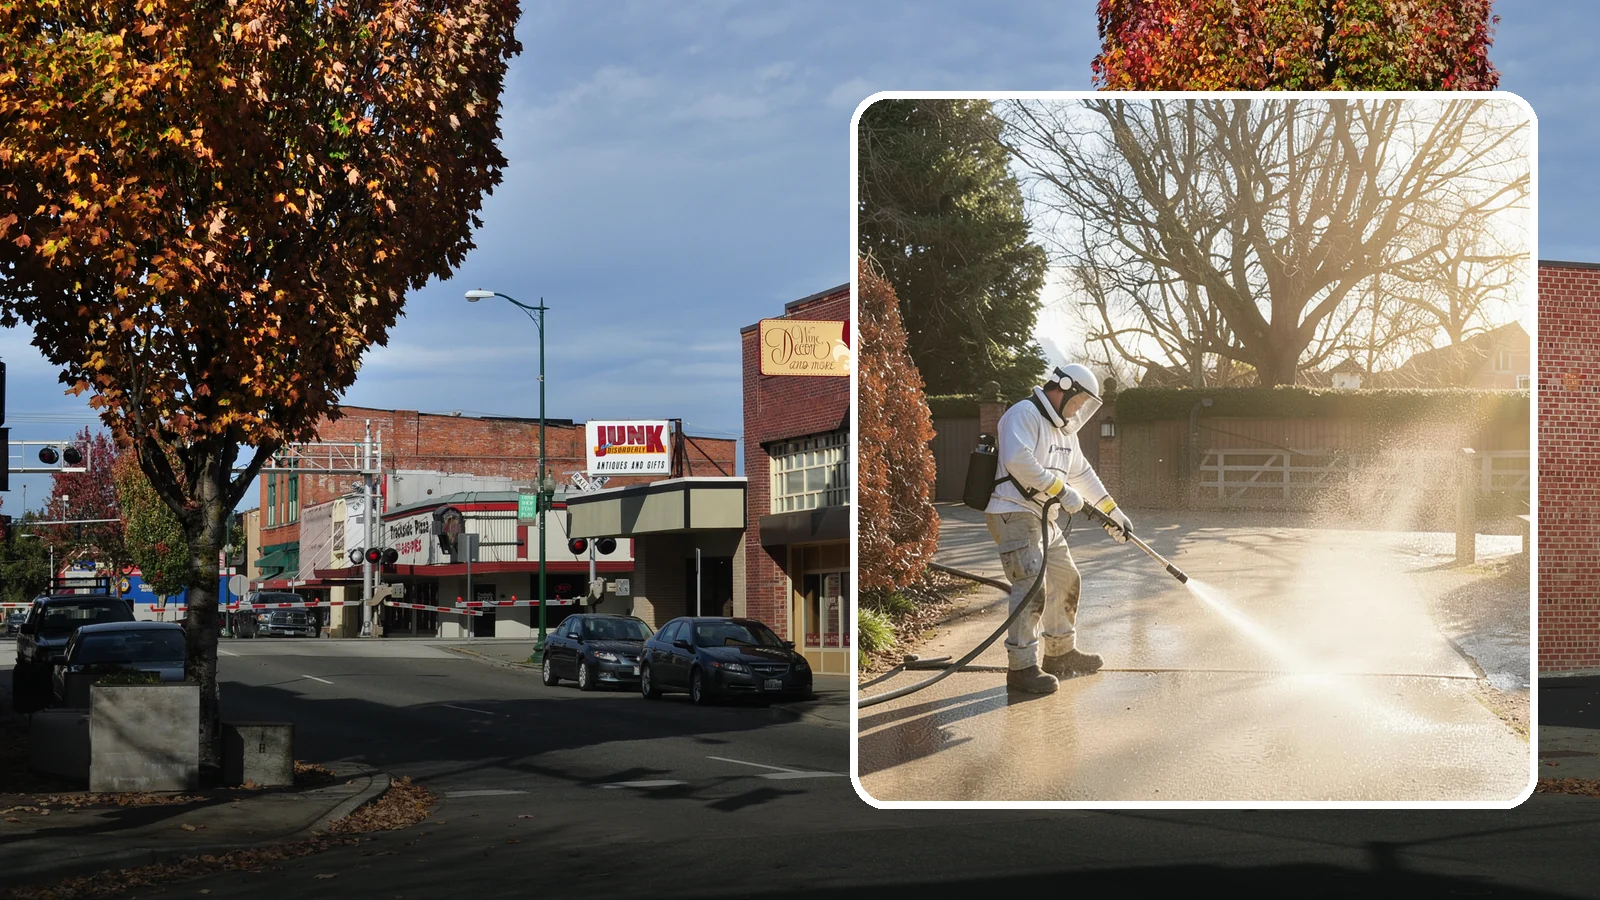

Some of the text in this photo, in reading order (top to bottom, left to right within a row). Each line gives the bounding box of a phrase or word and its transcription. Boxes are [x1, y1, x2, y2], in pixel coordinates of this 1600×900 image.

[595, 425, 665, 457] JUNK
[608, 446, 645, 454] DISORDERLY
[597, 460, 665, 470] ANTIQUES AND GIFTS
[414, 519, 429, 535] Pizza
